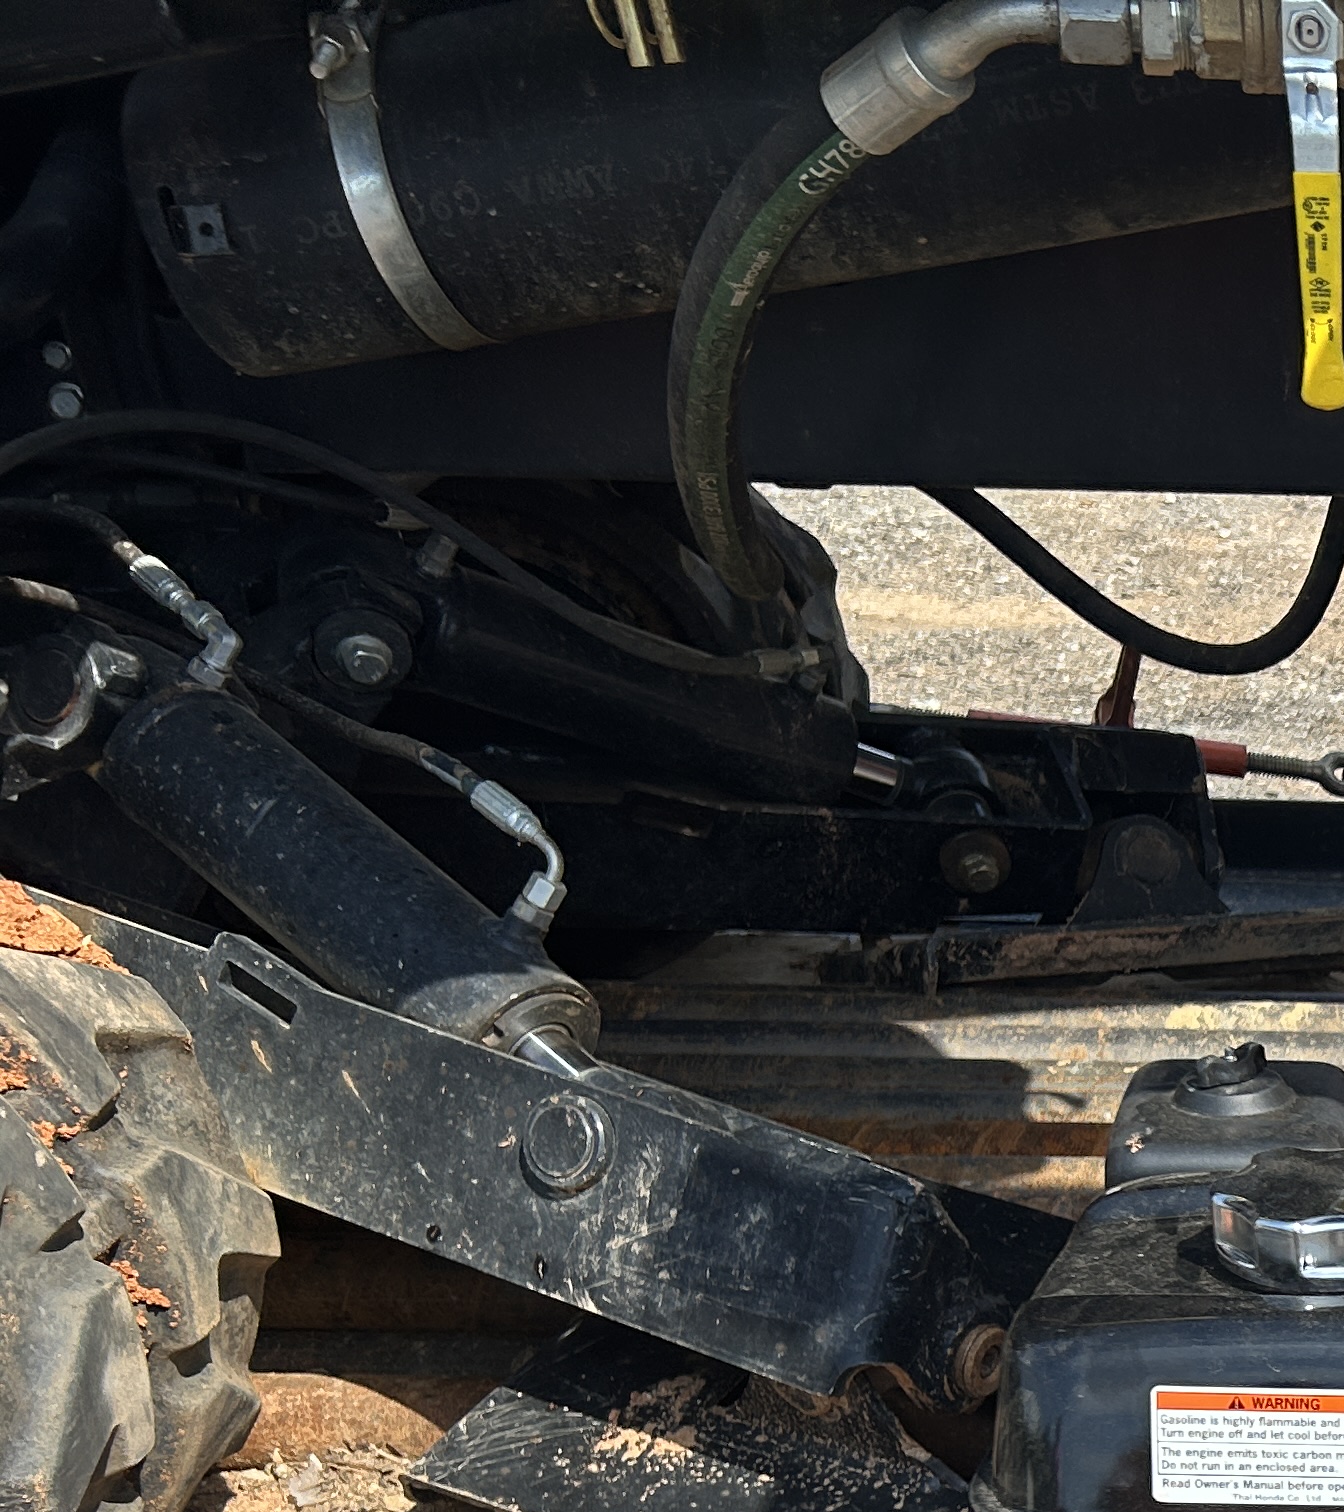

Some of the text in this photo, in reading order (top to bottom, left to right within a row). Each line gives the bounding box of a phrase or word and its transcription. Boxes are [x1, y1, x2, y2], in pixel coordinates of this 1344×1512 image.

[1252, 1397, 1321, 1411] WARNING
[1160, 1414, 1206, 1426] Gasoline
[1210, 1415, 1219, 1425] is
[1223, 1416, 1255, 1429] highly
[1259, 1417, 1317, 1428] flammable
[1320, 1418, 1341, 1428] and
[1161, 1428, 1184, 1438] Turn
[1188, 1430, 1224, 1440] engine
[1228, 1429, 1243, 1439] off
[1247, 1430, 1266, 1440] and
[1270, 1430, 1284, 1440] let
[1287, 1430, 1310, 1440] cool
[1161, 1447, 1182, 1457] The
[1186, 1449, 1223, 1460] engine
[1227, 1449, 1258, 1459] emits
[1261, 1449, 1289, 1460] toxic
[1293, 1450, 1332, 1460] carbon
[1161, 1461, 1339, 1473] Do not run in an enclosed area.
[1162, 1478, 1191, 1489] Read
[1194, 1479, 1239, 1489] Owner's
[1243, 1480, 1284, 1490] Manual
[1287, 1481, 1324, 1491] before
